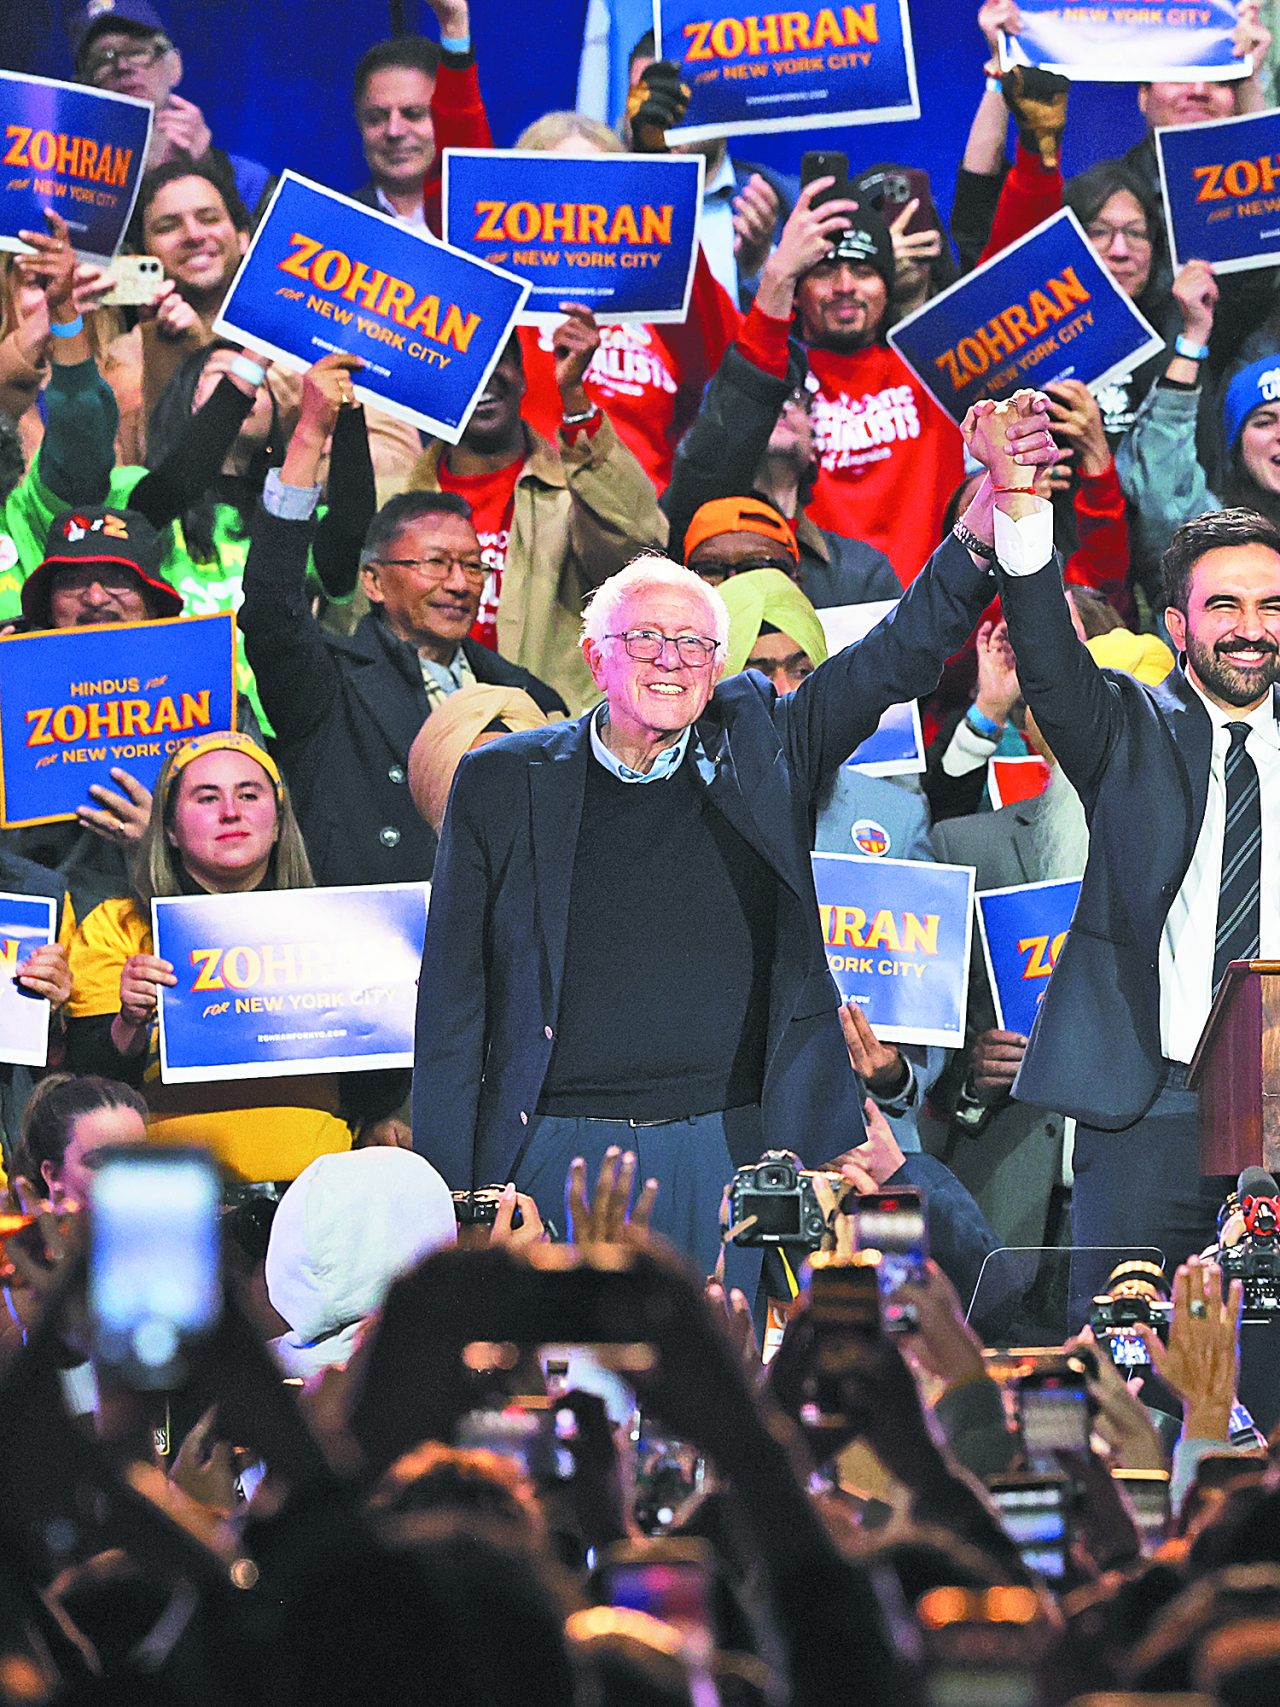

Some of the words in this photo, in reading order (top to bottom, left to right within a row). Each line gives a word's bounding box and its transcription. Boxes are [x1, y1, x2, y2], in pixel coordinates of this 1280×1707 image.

[683, 3, 880, 62] ZOHRAN
[1113, 8, 1162, 24] YORK
[1167, 9, 1212, 25] CITY
[723, 61, 768, 79] NEW
[773, 57, 824, 76] YORK
[827, 52, 872, 70] CITY
[1, 125, 133, 187] ZOHRAN
[33, 179, 67, 197] NEW
[473, 200, 675, 245] ZOHRAN
[513, 250, 560, 266] NEW
[565, 251, 617, 268] YORK
[620, 252, 662, 269] CITY
[277, 231, 482, 354] ZOHRAN
[275, 287, 305, 302] FOR
[307, 294, 354, 327] NEW
[357, 316, 402, 351] YORK
[407, 340, 452, 370] CITY
[935, 265, 1092, 392] ZOHRAN
[986, 365, 1020, 391] NEW
[1018, 338, 1061, 372] YORK
[1058, 309, 1096, 345] CITY
[70, 677, 140, 697] HINDUS
[24, 689, 211, 747] ZOHRAN
[62, 748, 108, 763] NEW
[110, 743, 161, 759] YORK
[876, 958, 927, 979] CITY
[202, 1001, 231, 1019] FOR
[235, 997, 283, 1014] NEW
[288, 991, 345, 1009] YORK
[351, 988, 397, 1007] CITY
